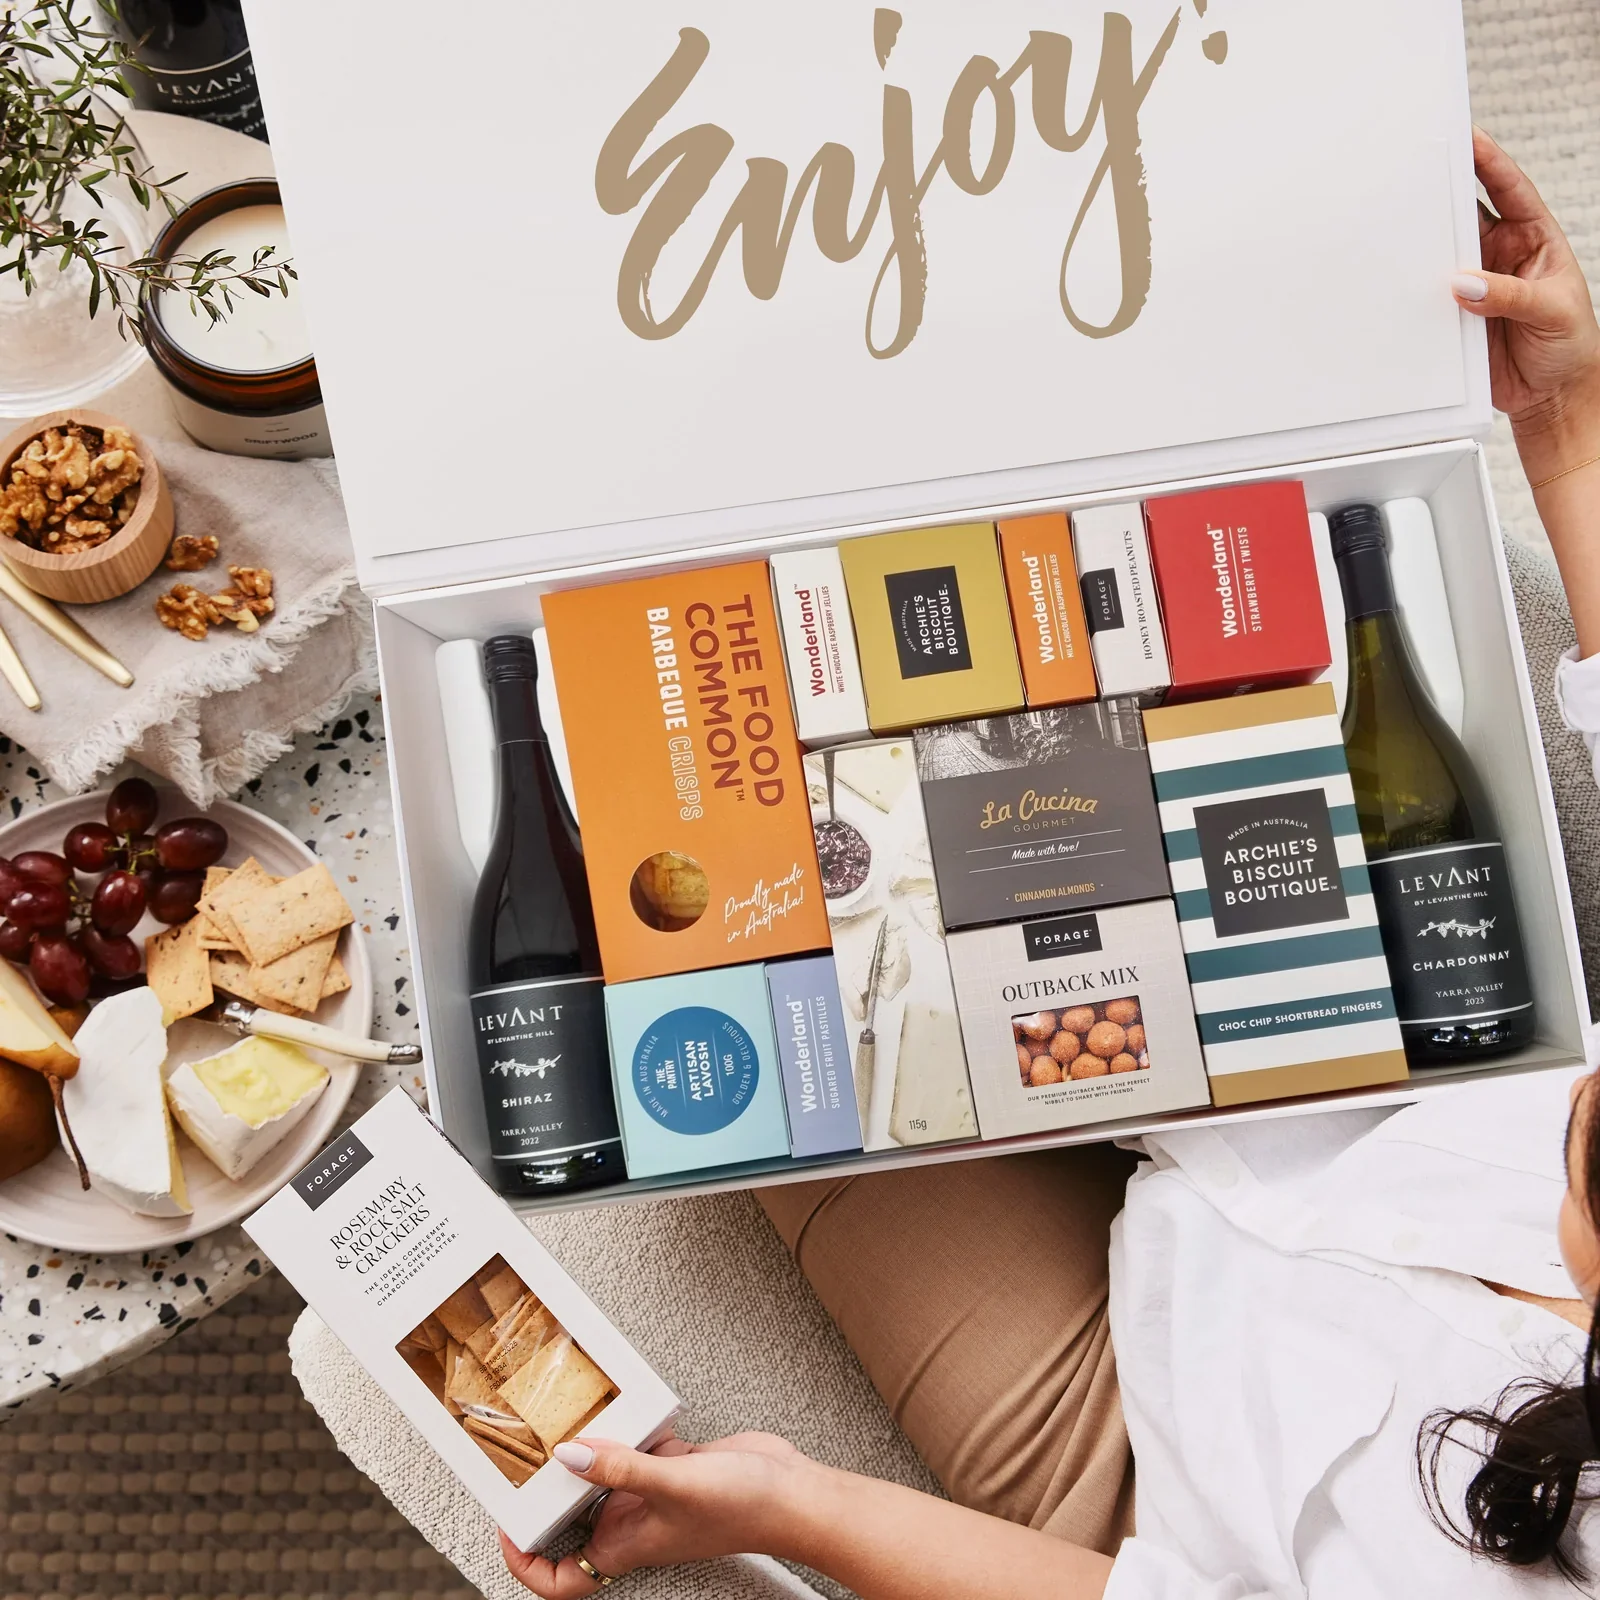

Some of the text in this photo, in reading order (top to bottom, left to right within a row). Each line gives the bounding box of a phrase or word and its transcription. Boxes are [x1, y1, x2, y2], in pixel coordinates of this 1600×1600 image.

[157, 64, 254, 95] LEVANT
[1123, 530, 1153, 660] HONEY ROASTED PEANUTS
[1207, 529, 1238, 638] Wonderland
[1238, 527, 1262, 631] STRAWBERRY TWISTS
[1023, 557, 1055, 664] Wonderland
[1050, 554, 1074, 658] MILK CHOCOLATE RASPBERRY JELLIES
[1098, 580, 1111, 620] FORAGE
[822, 586, 845, 693] WHITE CHOCOLATE RASPBERRY JELLIES
[914, 595, 932, 655] ARCHIE'S
[927, 598, 944, 649] BISCUIT
[938, 589, 958, 655] BOUTIQUE
[795, 590, 826, 697] Wonderland
[907, 638, 917, 652] MADE
[647, 606, 704, 821] BARBEQUE CRISPS
[685, 602, 744, 790] COMMON
[723, 594, 785, 807] THE FOOD
[980, 787, 1098, 829] La Cucina
[1014, 817, 1076, 832] GOURMET
[1227, 819, 1308, 841] MADE IN AUSTRALIA
[1012, 841, 1080, 860] Made with love!
[1224, 838, 1318, 865] ARCHIE'S
[1233, 858, 1314, 884] BISCUIT
[1399, 866, 1491, 894] LEVANT
[724, 863, 804, 924] Proudly made
[1015, 883, 1095, 902] CINNAMON ALMONDS
[1225, 877, 1330, 905] BOUTIQUE
[1427, 893, 1472, 904] LEVANTINE
[727, 888, 805, 943] in Australia!
[1034, 929, 1090, 946] FORAGE
[1413, 950, 1511, 972] CHARDONNAY
[1002, 966, 1140, 1002] OUTBACK MIX
[1435, 982, 1504, 998] YARRA VALLEY
[1465, 996, 1485, 1006] 2023
[479, 1005, 564, 1032] LEVANT
[1218, 1000, 1383, 1032] CHOC CHIP SHORTBREAD FINGERS
[494, 1032, 534, 1044] LEVANTINE
[536, 1030, 555, 1038] HILL
[722, 1022, 751, 1061] DELICIOUS
[787, 1000, 817, 1113] Wonderland
[816, 996, 840, 1109] SUGARED FRUIT PASTILLES
[640, 1035, 669, 1118] MADE IN AUSTRALIA
[656, 1068, 666, 1084] THE
[664, 1060, 678, 1090] PANTRY
[685, 1040, 702, 1101] ARTISAN
[697, 1042, 714, 1097] LAVOSH
[723, 1054, 735, 1076] 100G
[502, 1093, 553, 1108] SHIRAZ
[732, 1073, 751, 1105] GOLDEN
[1041, 1091, 1067, 1100] PREMIUM
[1069, 1087, 1095, 1095] OUTBACK
[1127, 1078, 1150, 1086] PERFECT
[1075, 1093, 1093, 1101] SHARE
[1110, 1087, 1136, 1095] FRIENDS.
[501, 1122, 564, 1137] YARRA VALLEY
[521, 1136, 539, 1146] 2022
[908, 1119, 927, 1131] 115g
[307, 1147, 355, 1192] FORAGE
[330, 1176, 407, 1250] ROSEMARY
[336, 1182, 425, 1269] & ROCK SALT
[356, 1204, 430, 1274] CRACKERS
[364, 1217, 450, 1295] THE IDEAL COMPLEMENT
[377, 1233, 459, 1306] CHARCUTERIE PLATTER.
[379, 1232, 445, 1292] TO ANY CHEESE OR
